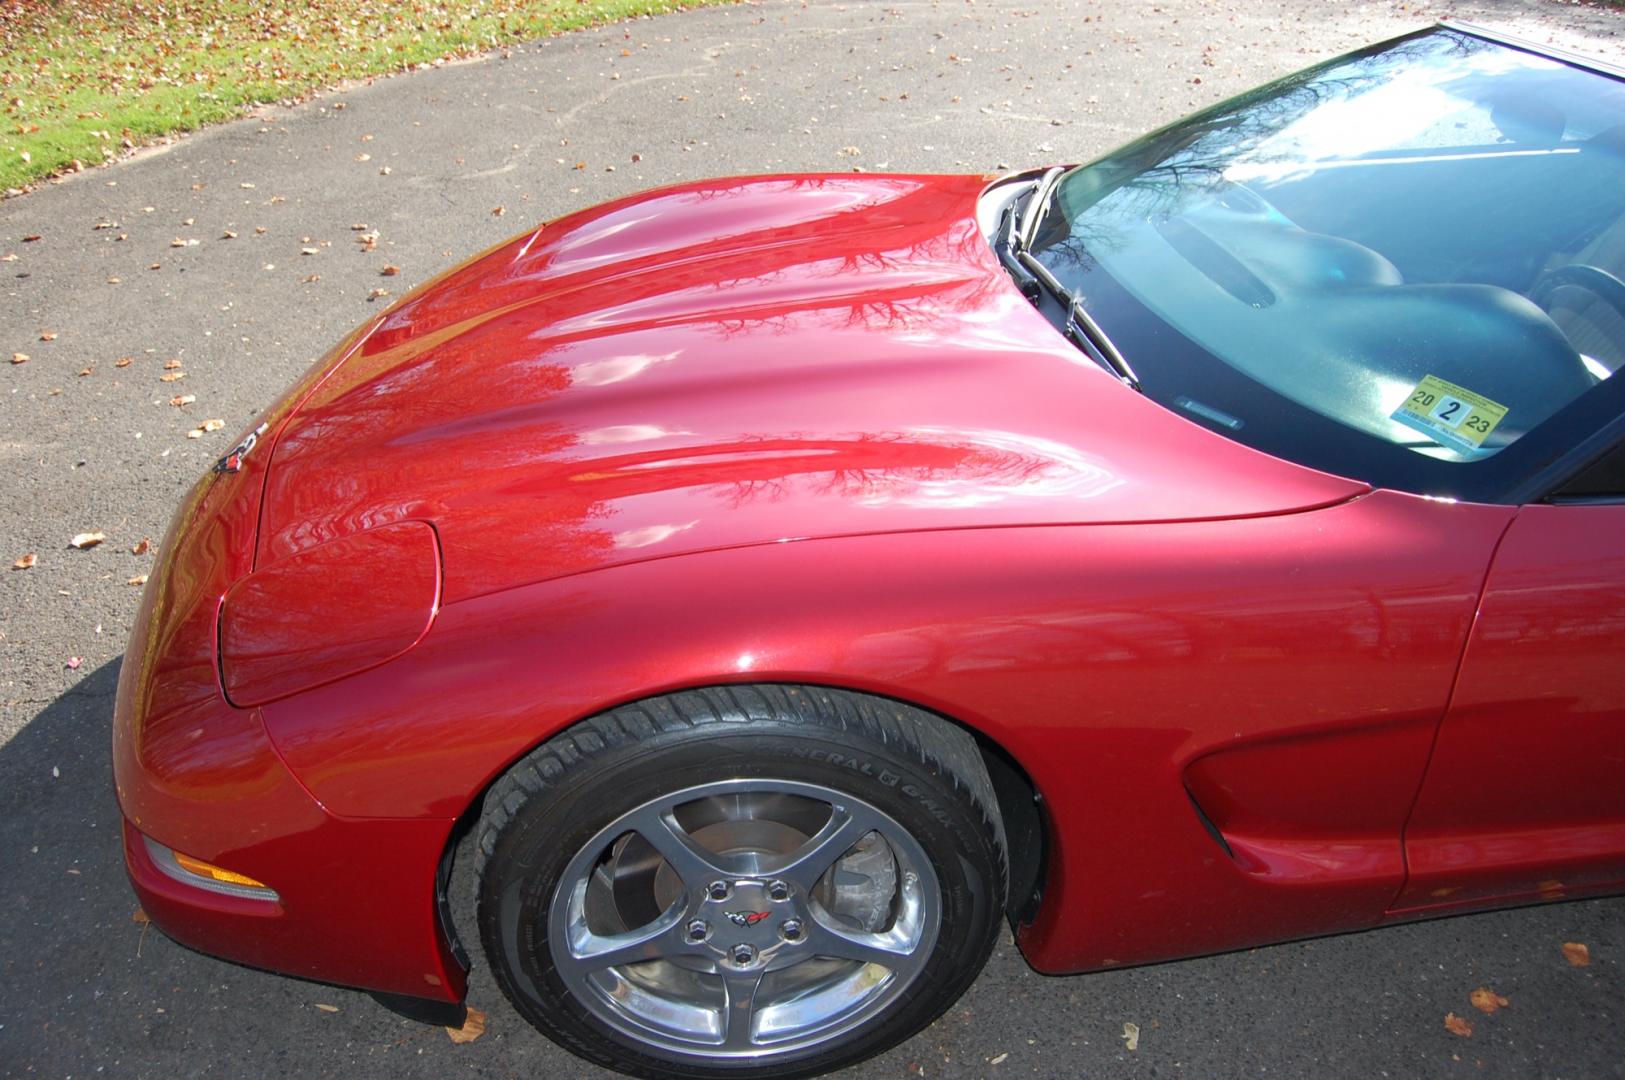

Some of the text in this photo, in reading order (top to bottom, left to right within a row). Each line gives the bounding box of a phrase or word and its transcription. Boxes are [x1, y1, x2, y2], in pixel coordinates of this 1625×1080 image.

[1412, 391, 1435, 406] 20
[1439, 401, 1461, 421] 2
[1465, 415, 1490, 433] 23
